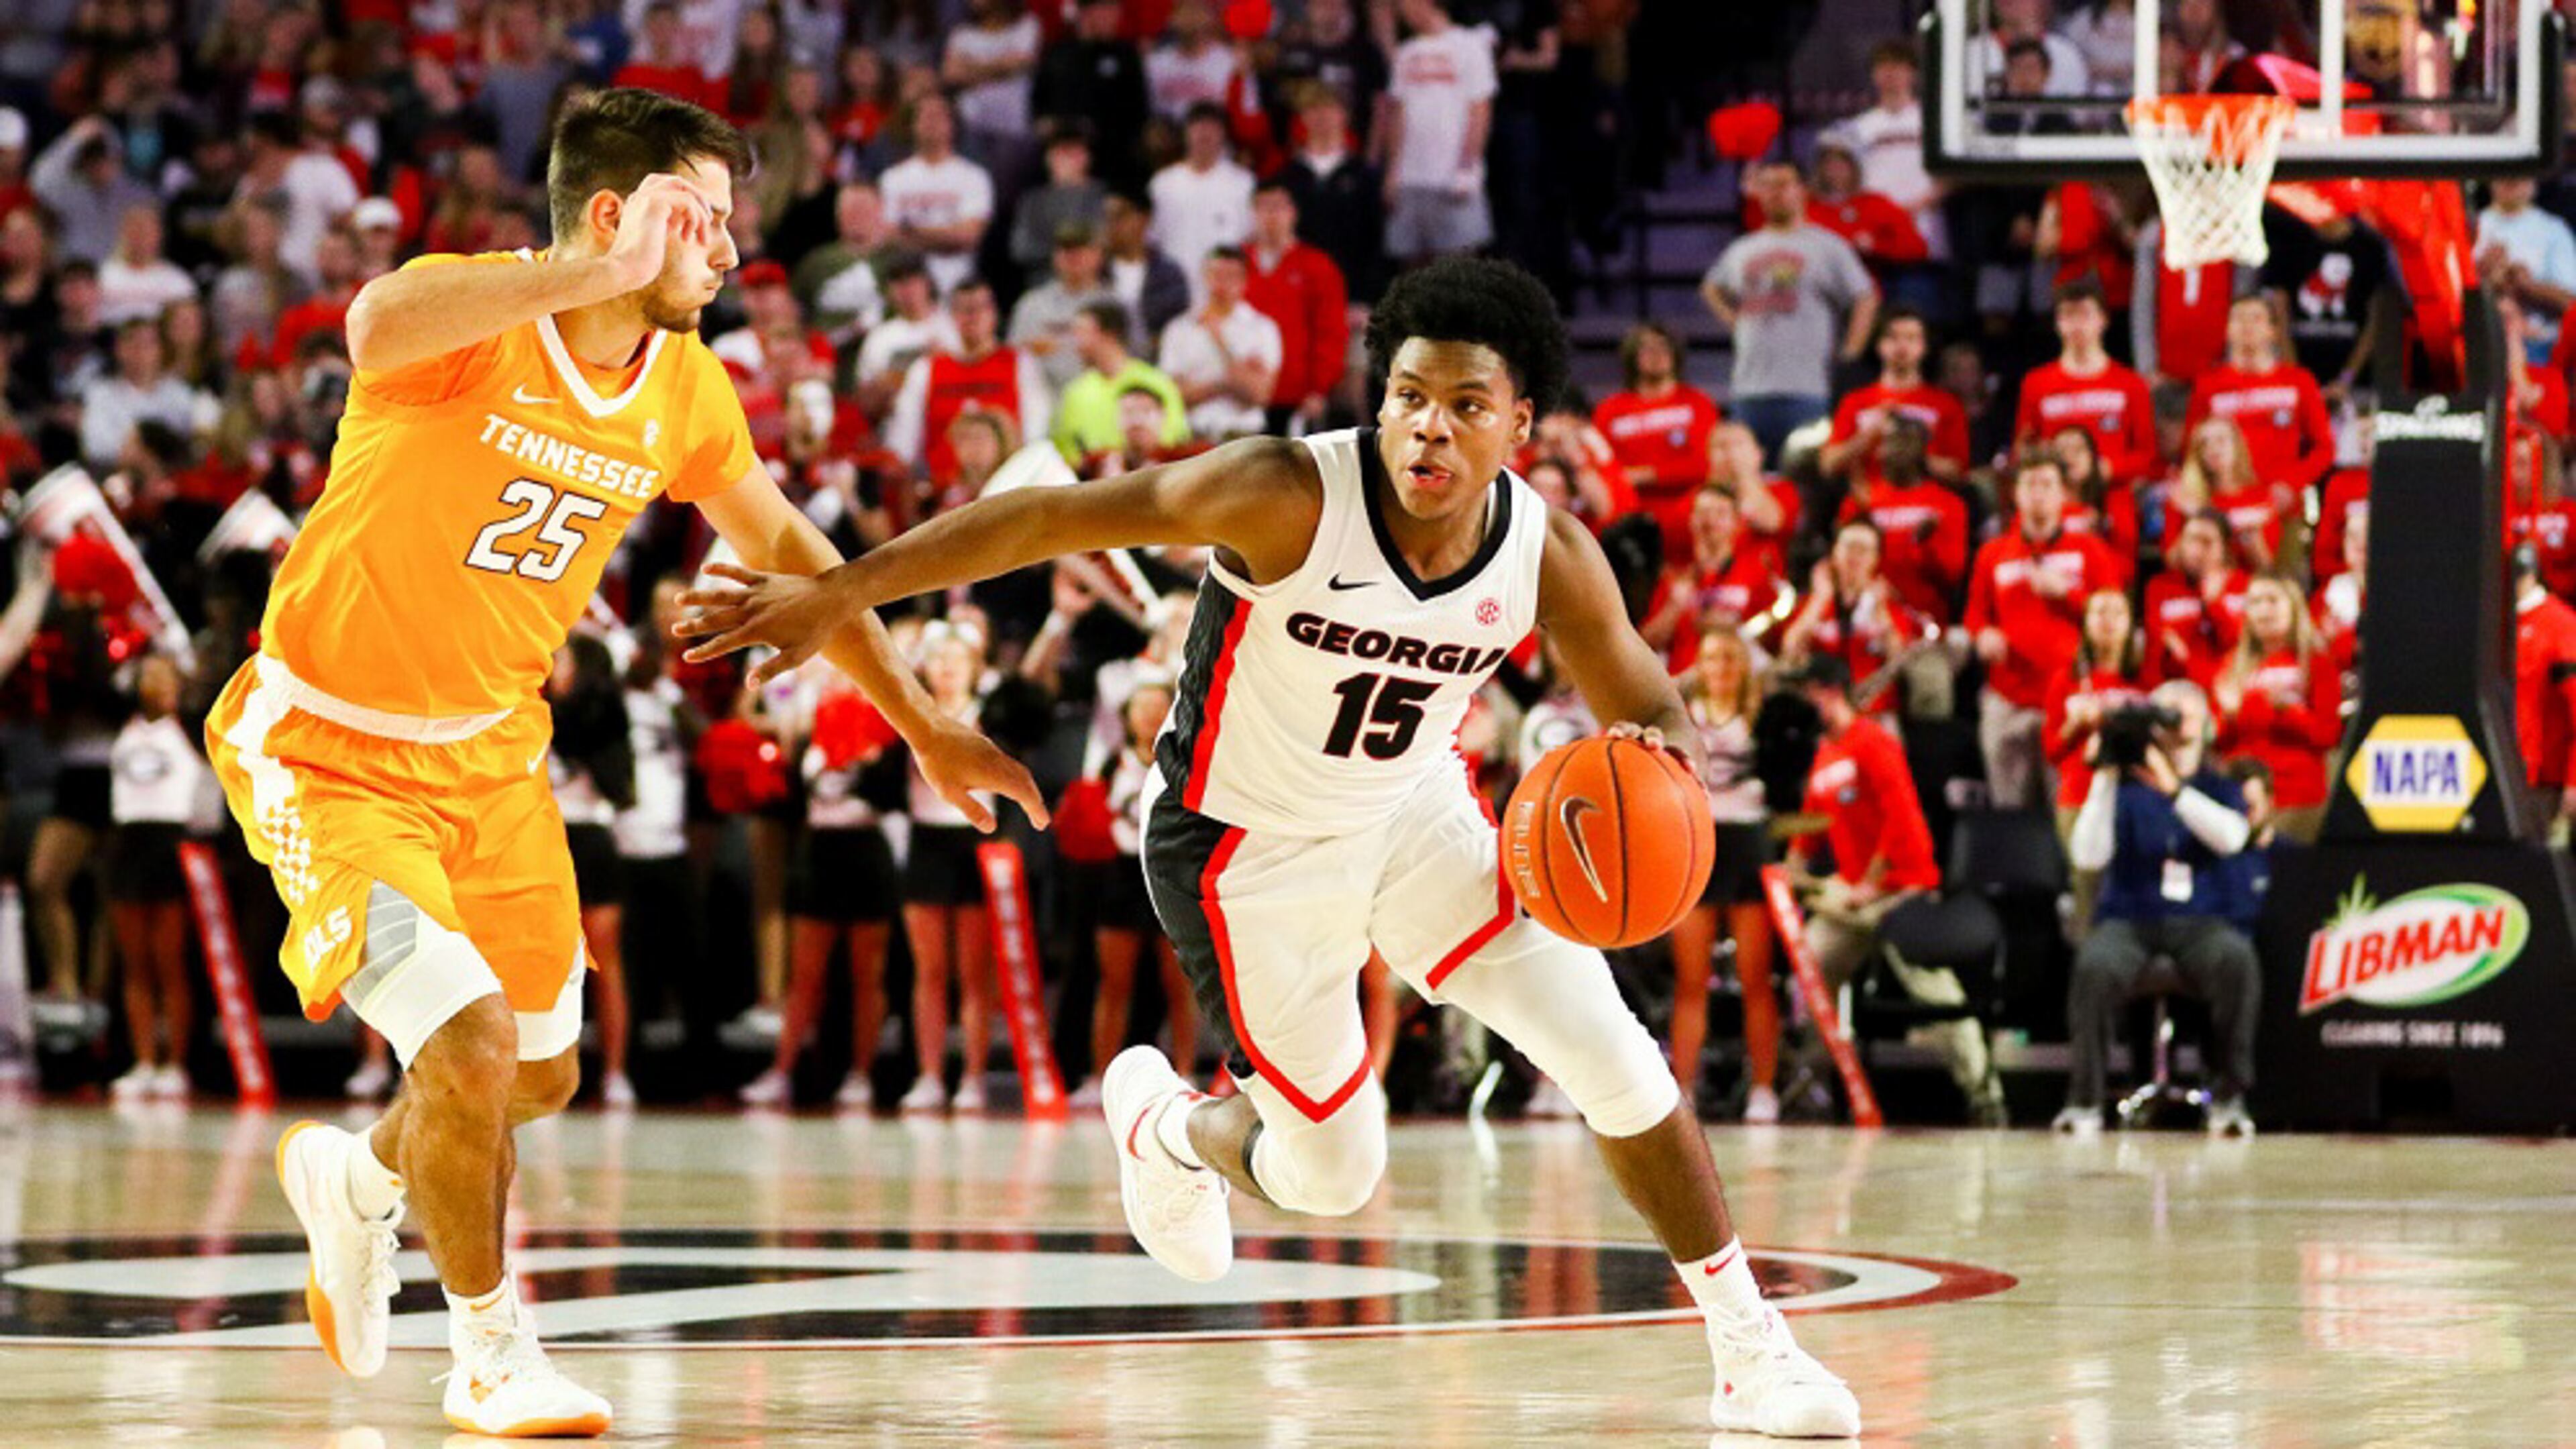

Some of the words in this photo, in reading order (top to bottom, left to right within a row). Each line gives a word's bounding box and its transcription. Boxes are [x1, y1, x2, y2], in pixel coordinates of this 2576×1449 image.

[479, 413, 659, 499] TENNESSEE
[465, 476, 608, 584] 25
[1322, 672, 1443, 761] 15
[2373, 751, 2461, 794] NAPA
[2304, 906, 2506, 1003] LIBMAN
